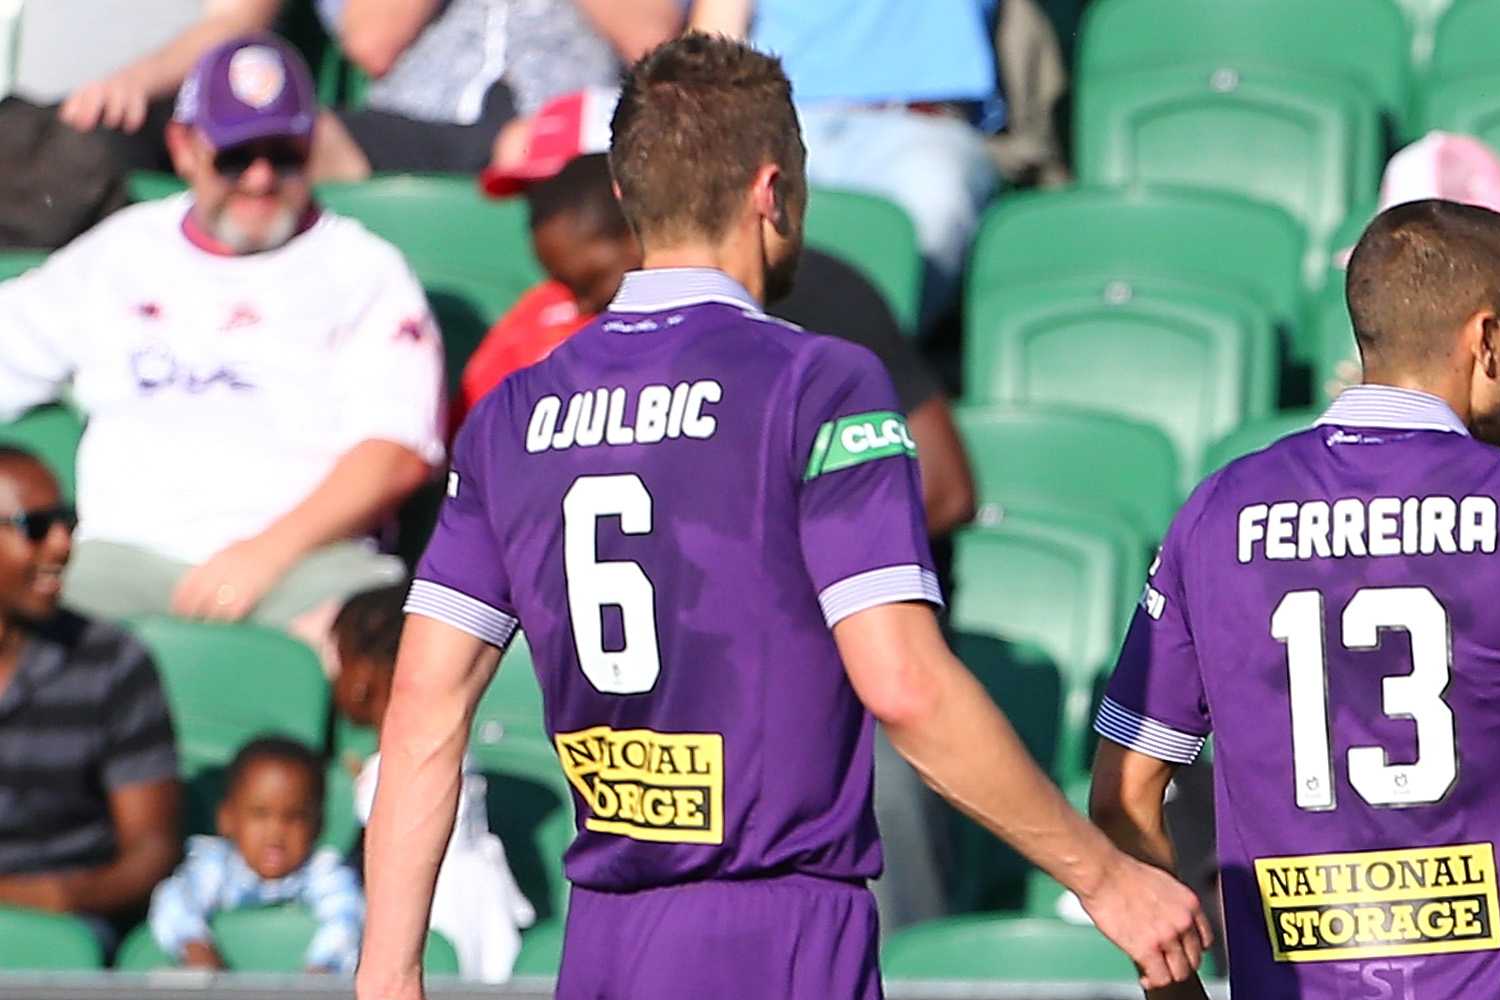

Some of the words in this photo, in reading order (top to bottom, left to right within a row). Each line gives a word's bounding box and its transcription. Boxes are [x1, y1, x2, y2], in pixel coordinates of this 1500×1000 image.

[526, 380, 722, 453] DJULBIC
[1238, 496, 1497, 562] FERREIRA
[562, 474, 661, 694] 6
[1270, 587, 1458, 813] 13
[1266, 855, 1485, 897] NATIONAL
[1280, 900, 1482, 947] STORAGE
